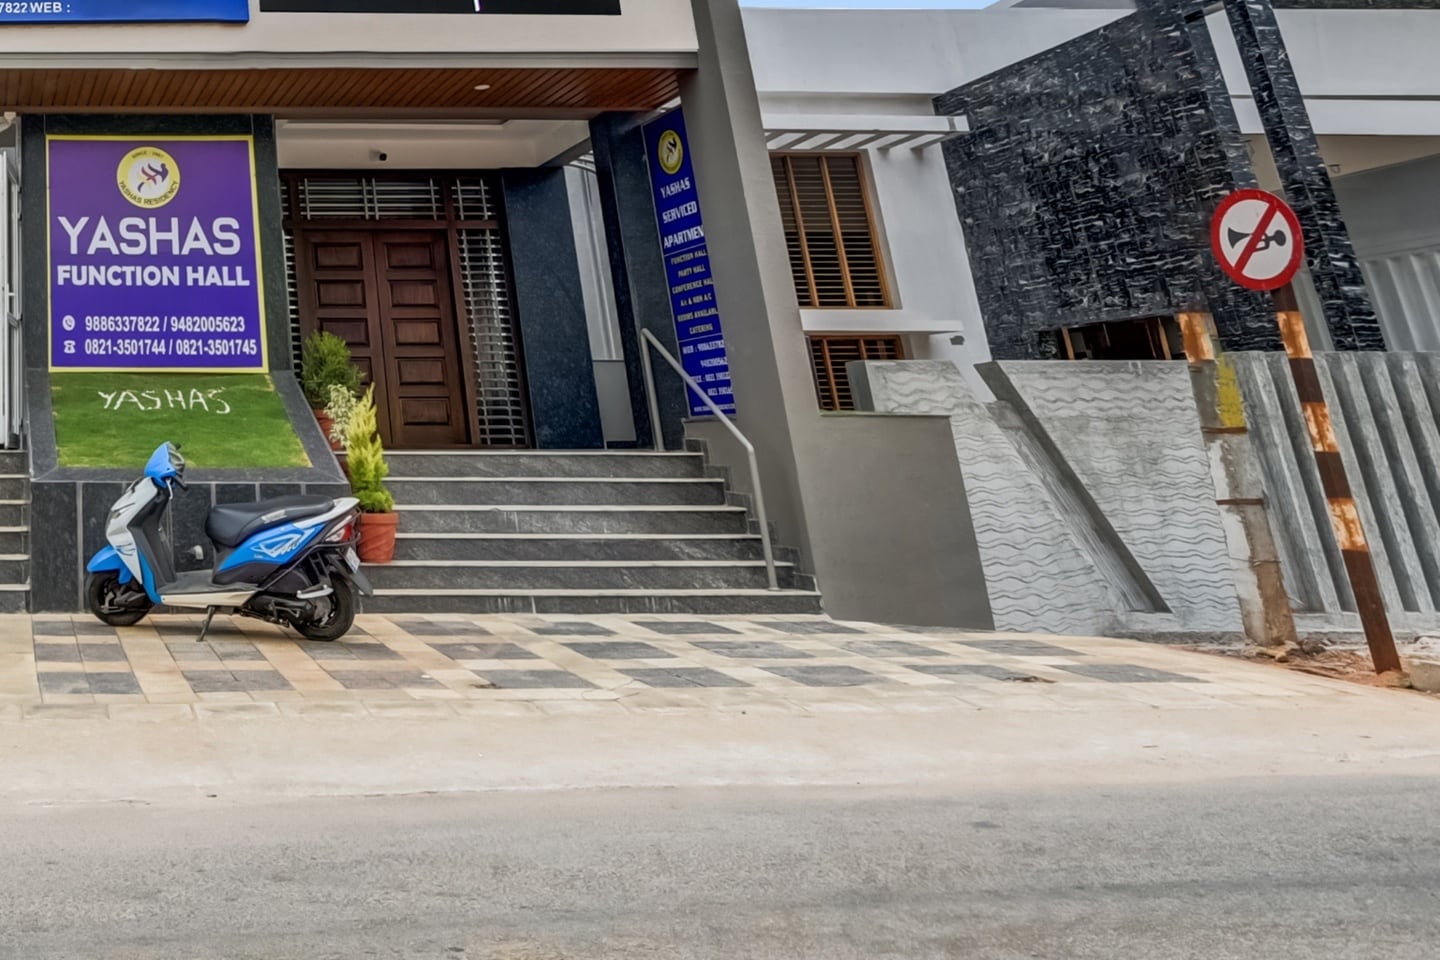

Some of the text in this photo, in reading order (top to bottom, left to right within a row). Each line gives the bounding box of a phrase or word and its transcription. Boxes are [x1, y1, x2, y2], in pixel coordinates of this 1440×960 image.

[29, 2, 63, 13] WEB
[660, 176, 691, 199] YASHAS
[662, 200, 698, 224] SERVICED
[57, 215, 241, 256] YASHAS
[663, 225, 704, 249] APARTMEN
[57, 264, 250, 287] FUNCTION HALL
[85, 315, 160, 332] 9886337822
[170, 315, 246, 333] 9482005623
[694, 307, 719, 319] AVAILABL
[84, 338, 166, 355] 0821-3501744
[176, 338, 257, 355] 0821-3501745
[98, 386, 231, 415] YASHAS
